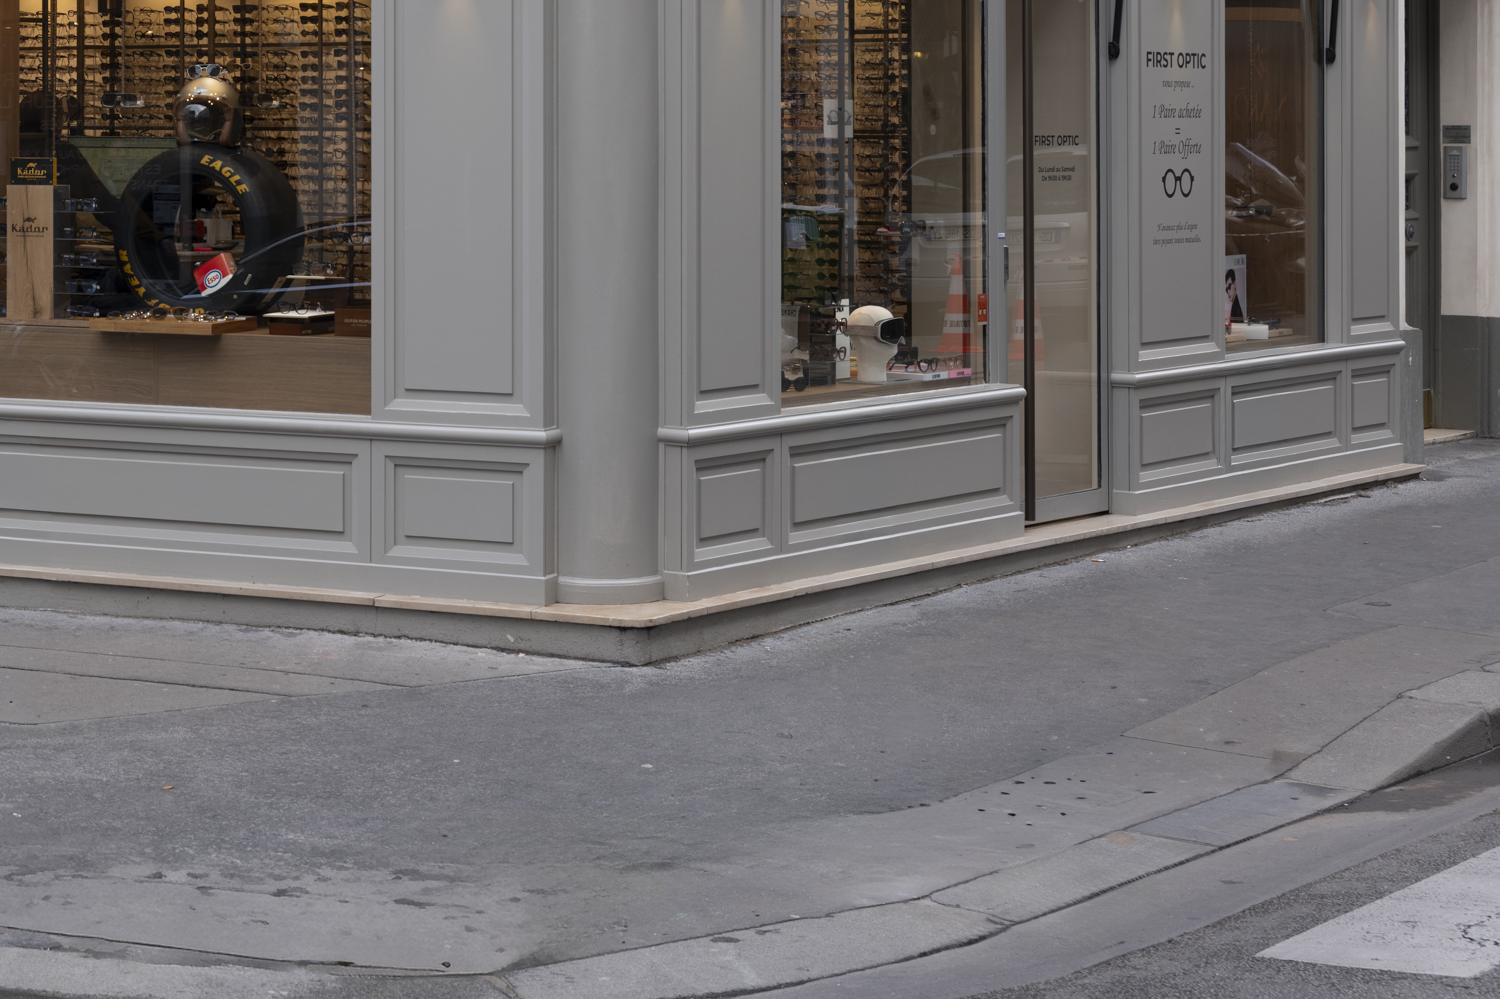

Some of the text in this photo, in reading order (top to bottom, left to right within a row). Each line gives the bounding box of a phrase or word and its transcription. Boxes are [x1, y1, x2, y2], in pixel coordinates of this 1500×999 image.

[1146, 51, 1206, 69] FIRST OPTIC
[1162, 80, 1173, 88] vous
[1152, 102, 1202, 119] 1 Paire achetée
[1034, 134, 1080, 146] FIRST OPTIC
[1152, 138, 1202, 160] 1 Paire Offerte
[200, 154, 250, 195] EAGLE
